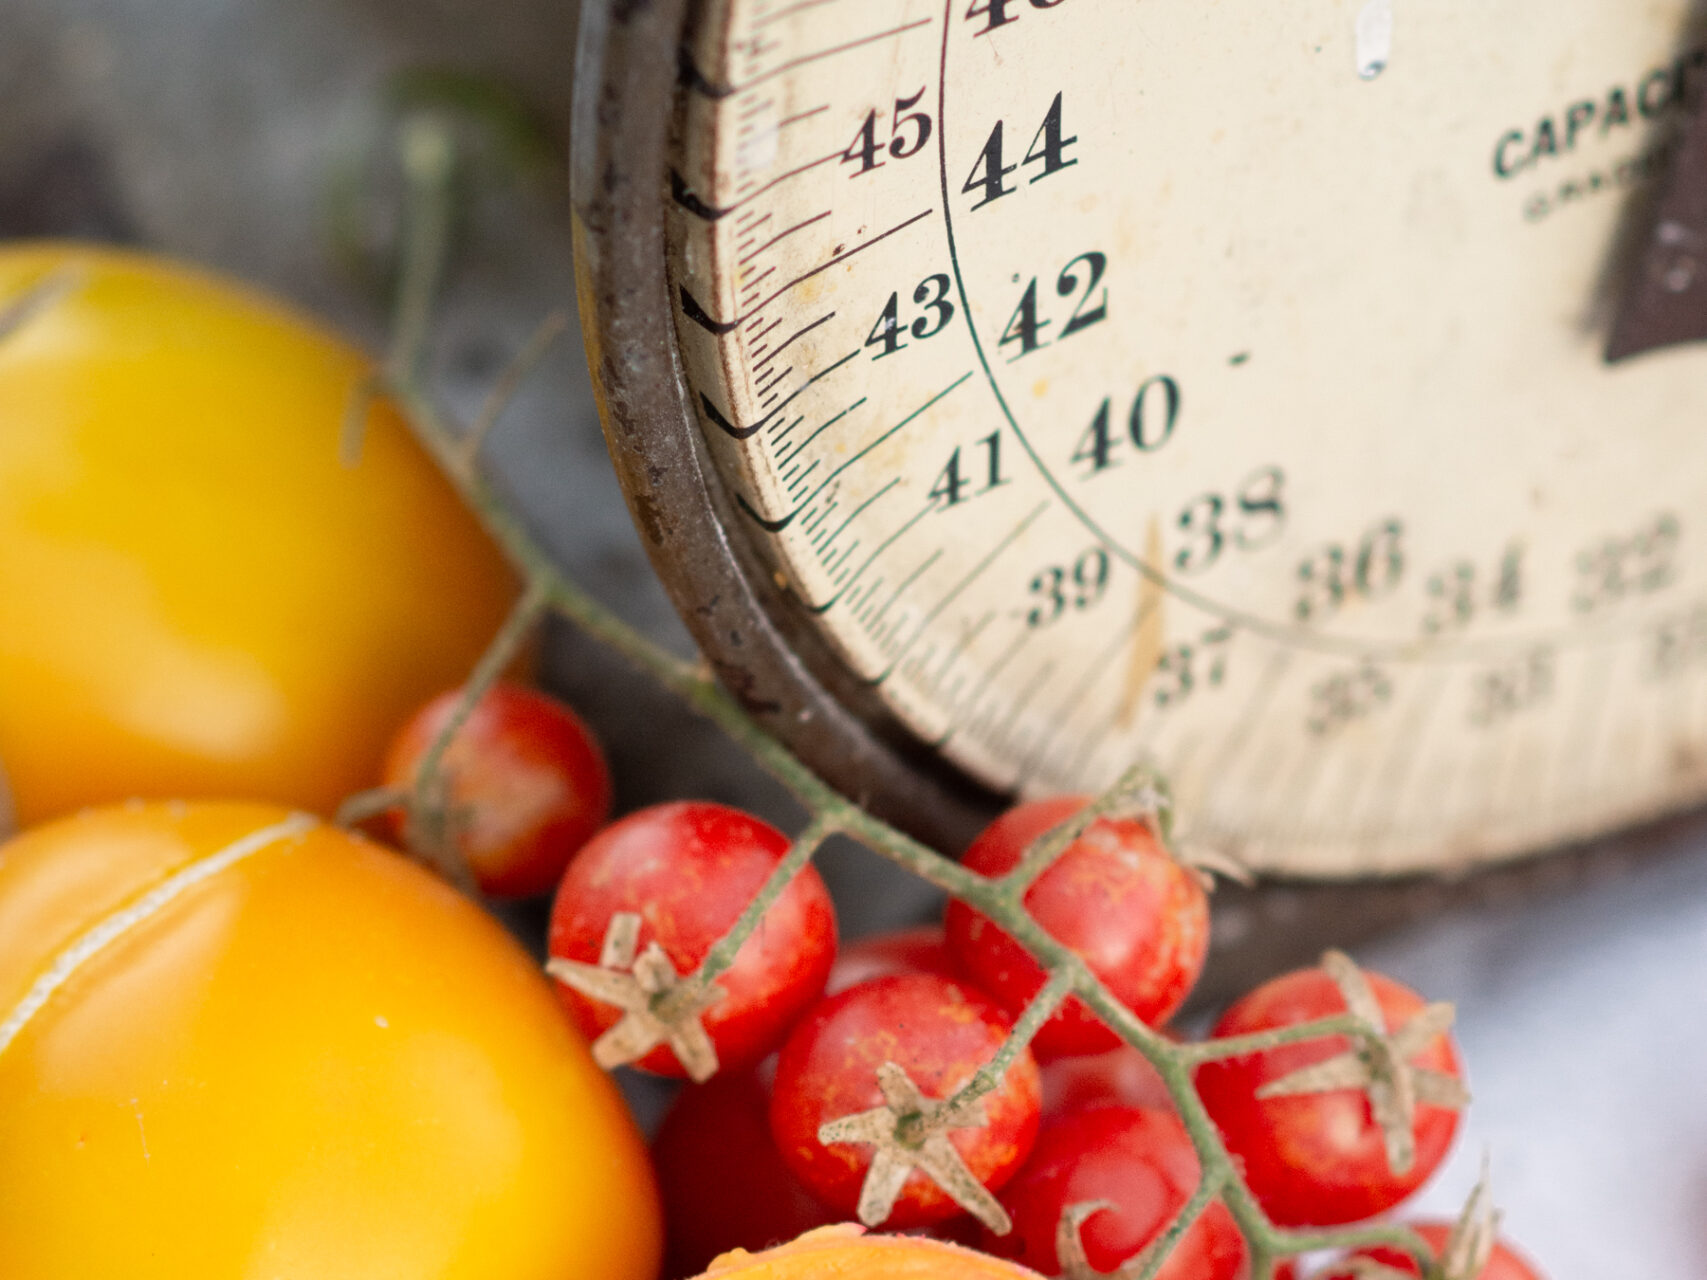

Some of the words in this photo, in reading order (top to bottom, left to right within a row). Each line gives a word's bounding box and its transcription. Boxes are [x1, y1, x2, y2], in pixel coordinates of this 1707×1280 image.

[840, 85, 932, 179] 45
[961, 91, 1078, 212] 44
[864, 273, 954, 361] 43
[997, 250, 1108, 363] 42
[927, 428, 1012, 513] 41
[1069, 374, 1181, 482] 40
[1174, 464, 1288, 574] 38
[1295, 514, 1404, 625] 36
[1026, 546, 1112, 628] 39
[1154, 624, 1232, 706] 37
